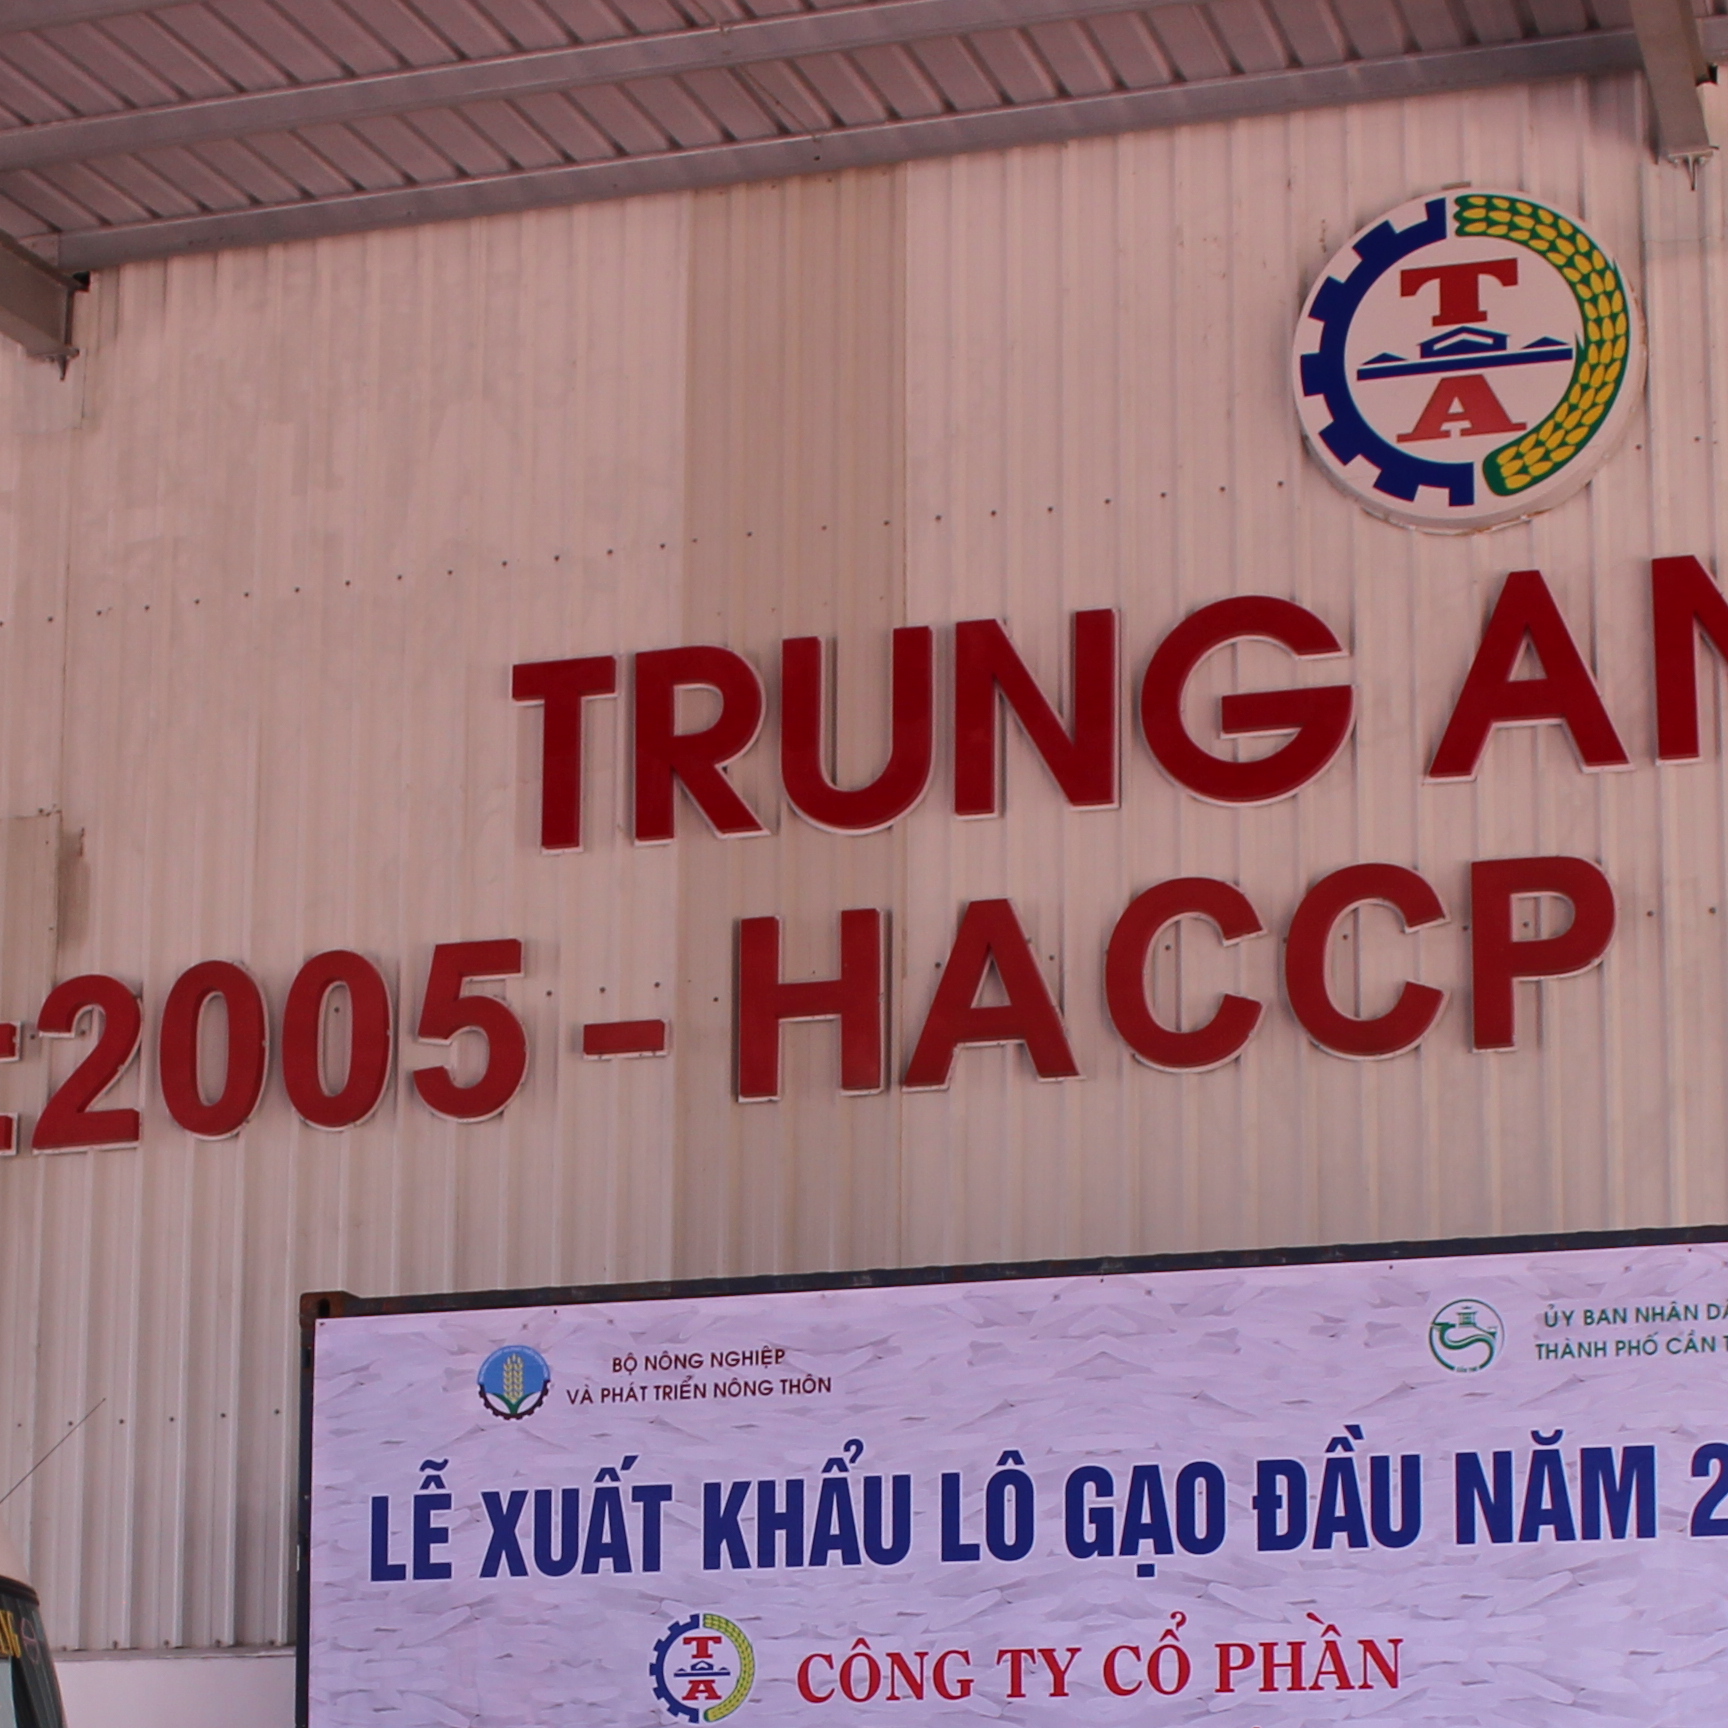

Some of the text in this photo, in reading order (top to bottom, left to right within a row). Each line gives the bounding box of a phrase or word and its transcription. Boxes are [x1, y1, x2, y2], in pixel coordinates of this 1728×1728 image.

[510, 595, 1356, 856] TRUNG
[734, 856, 1617, 1103] HACCP
[1544, 1303, 1575, 1328] ỦY
[1583, 1307, 1627, 1326] BAN
[1635, 1301, 1699, 1324] NHÂN
[612, 1345, 787, 1376] BỘ NÔNG NGHIỆP
[1535, 1338, 1607, 1361] THÀNH
[1615, 1331, 1659, 1357] PHỐ
[1665, 1332, 1716, 1355] CẦN
[566, 1373, 833, 1405] VÀ PHÁT TRIỂN NÔNG THÔN
[370, 1456, 453, 1583] LỄ
[479, 1454, 674, 1579] XUẤT
[702, 1438, 913, 1571] KHẨU
[940, 1449, 1035, 1563] LÔ
[1065, 1461, 1227, 1582] GẠO
[1252, 1424, 1422, 1553] ĐẦU
[1455, 1429, 1658, 1546] NĂM
[796, 1612, 1404, 1704] CÔNG TY CỔ PHẦN
